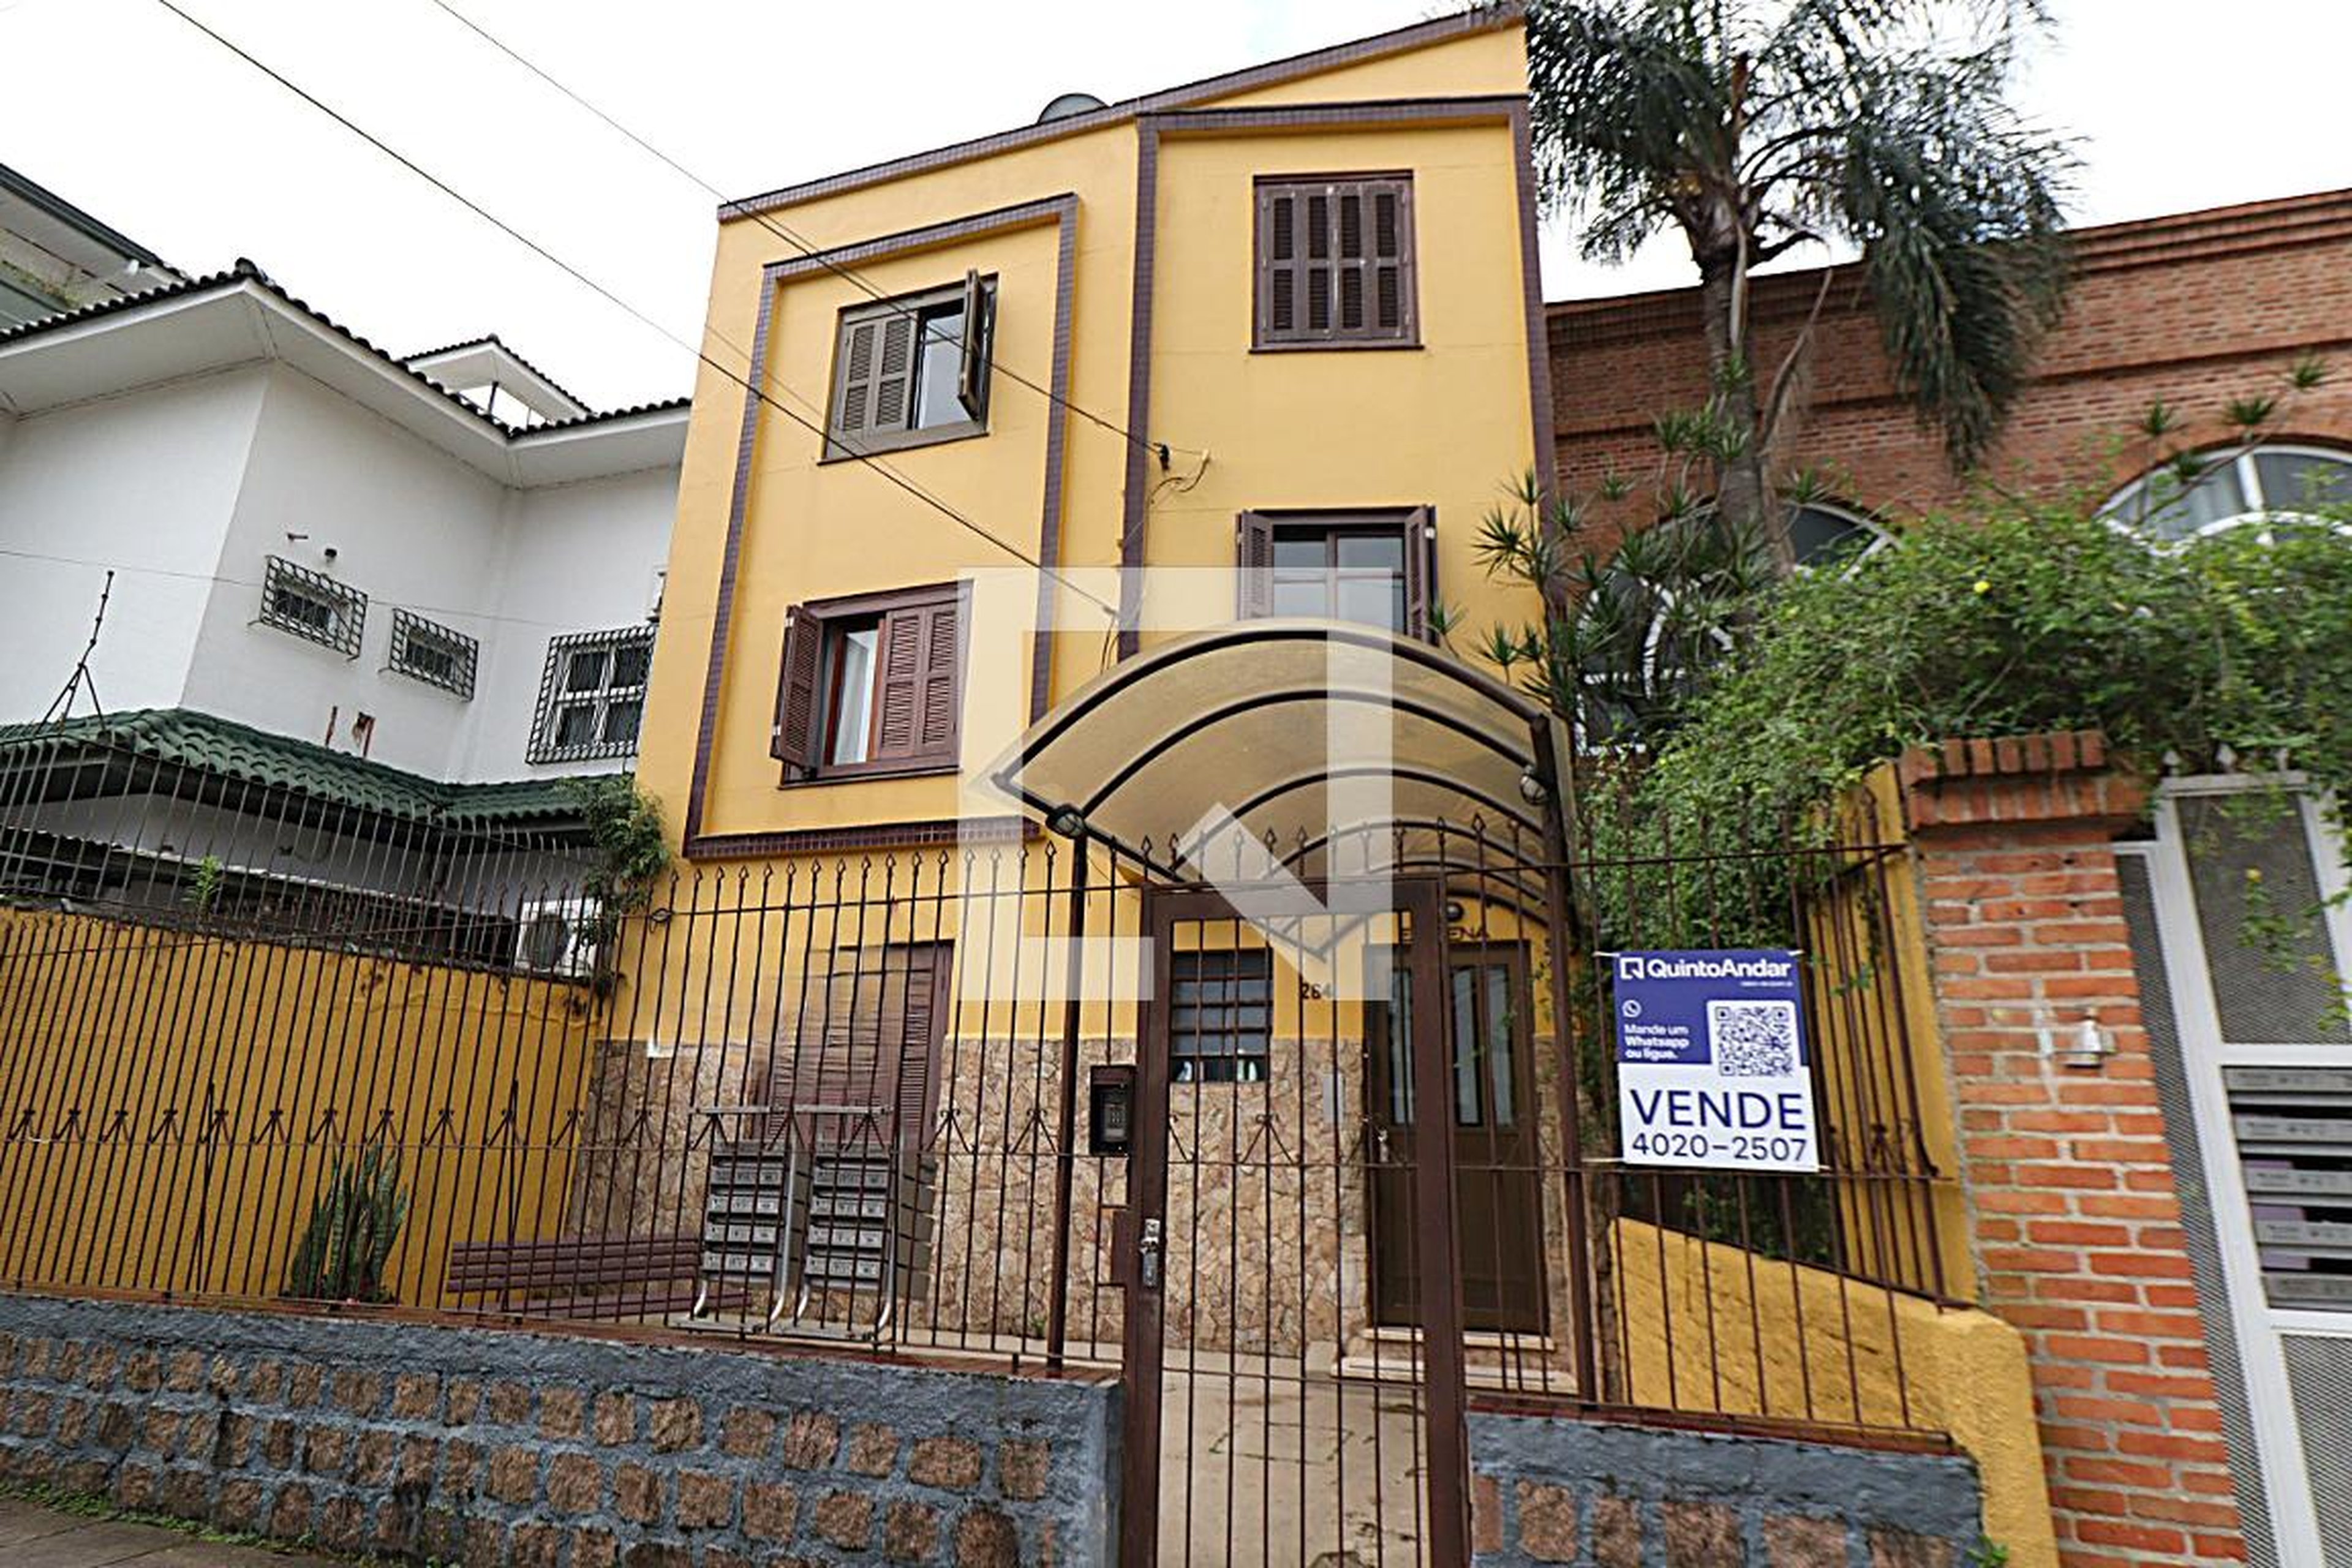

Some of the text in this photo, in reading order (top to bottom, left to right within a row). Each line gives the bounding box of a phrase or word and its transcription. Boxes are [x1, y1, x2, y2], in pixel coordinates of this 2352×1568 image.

[1647, 958, 1792, 978] QuintoAndar
[1624, 1024, 1689, 1035] Mande um
[1624, 1036, 1689, 1049] Whatsapp
[1625, 1049, 1642, 1058] ou
[1629, 1089, 1806, 1130] VENDE
[1632, 1133, 1807, 1161] 4020-2507
